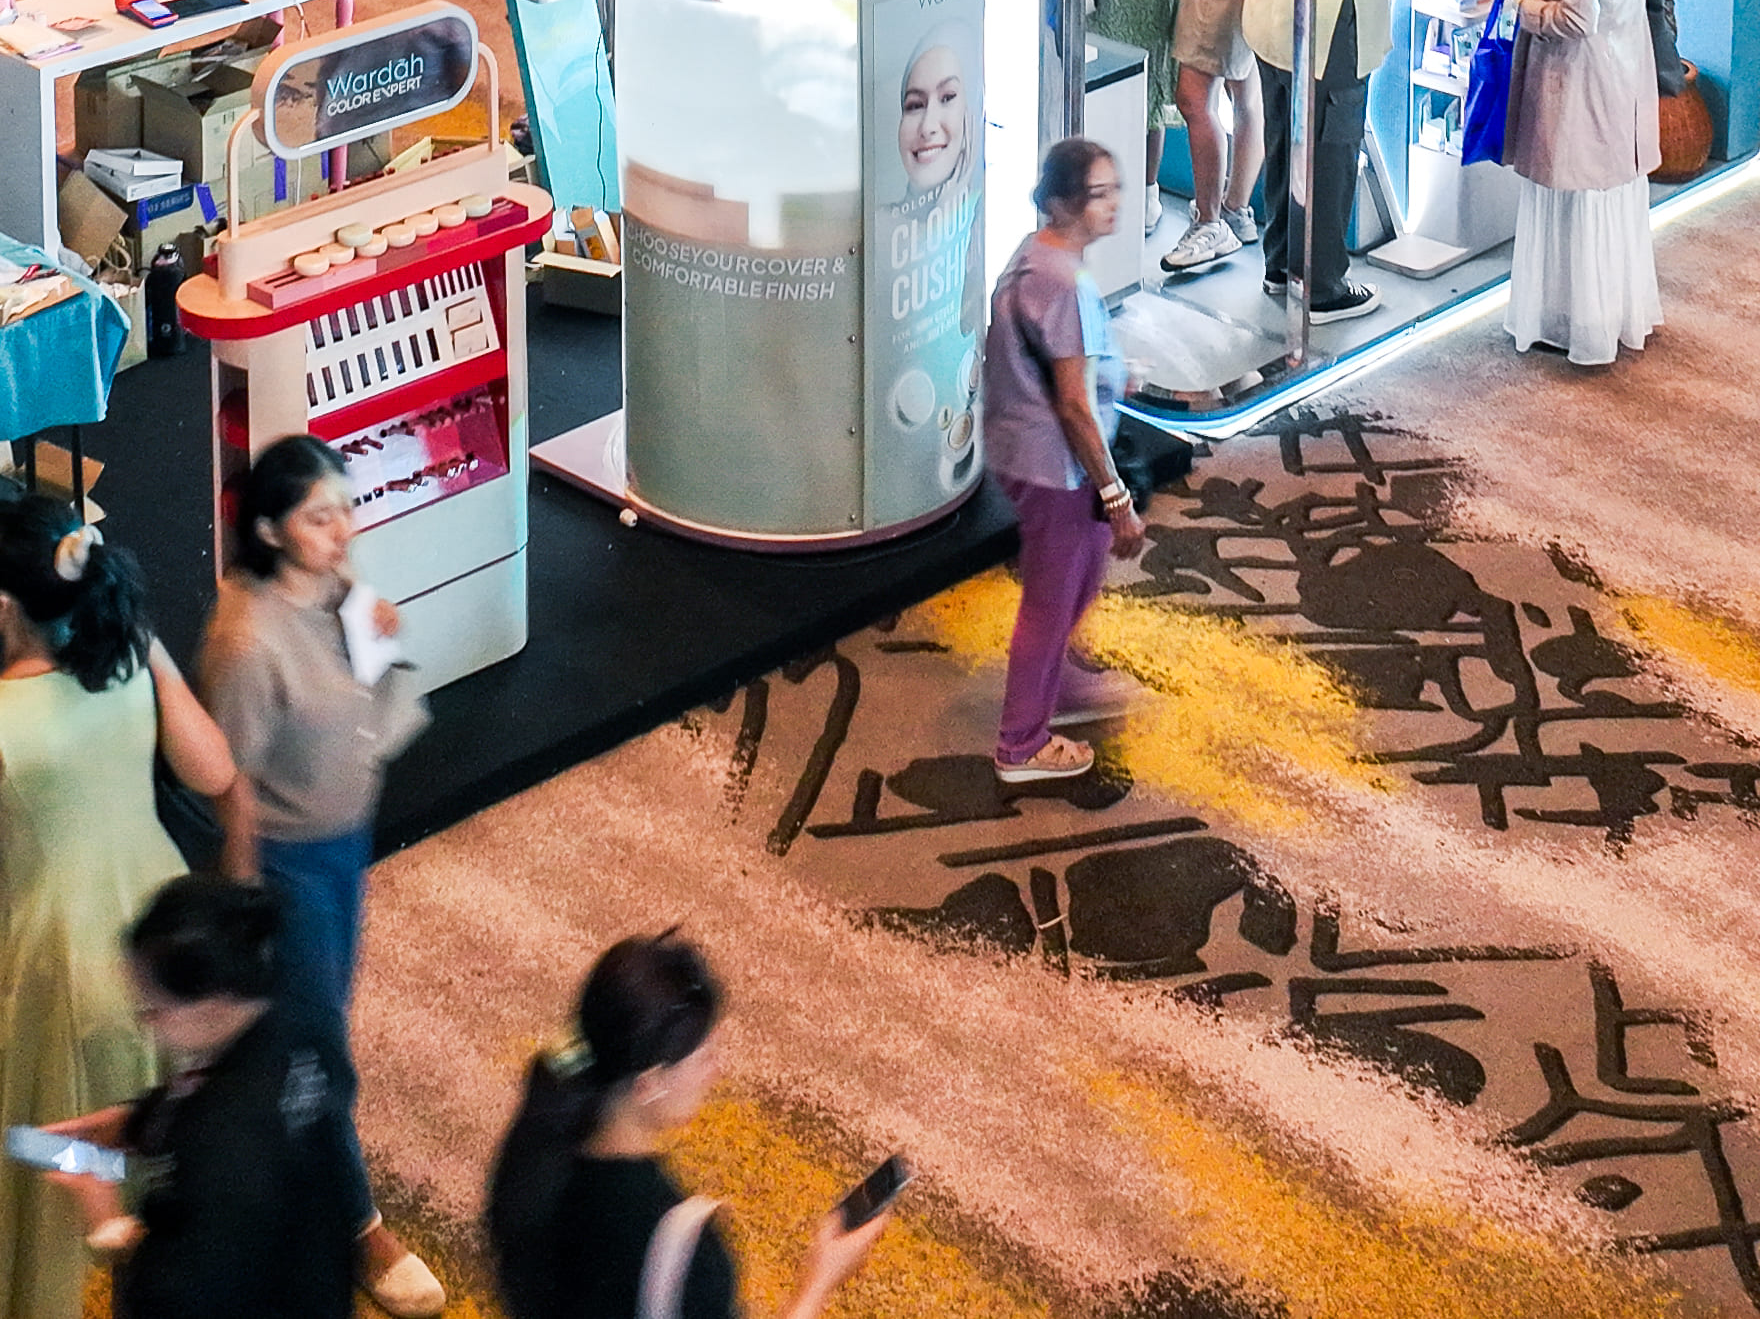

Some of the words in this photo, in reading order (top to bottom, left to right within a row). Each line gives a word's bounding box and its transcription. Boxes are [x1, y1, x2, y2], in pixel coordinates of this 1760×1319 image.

[326, 90, 371, 117] COLOR
[371, 75, 423, 104] EXPERT
[891, 186, 970, 270] CLOUD
[765, 281, 836, 301] FINISH
